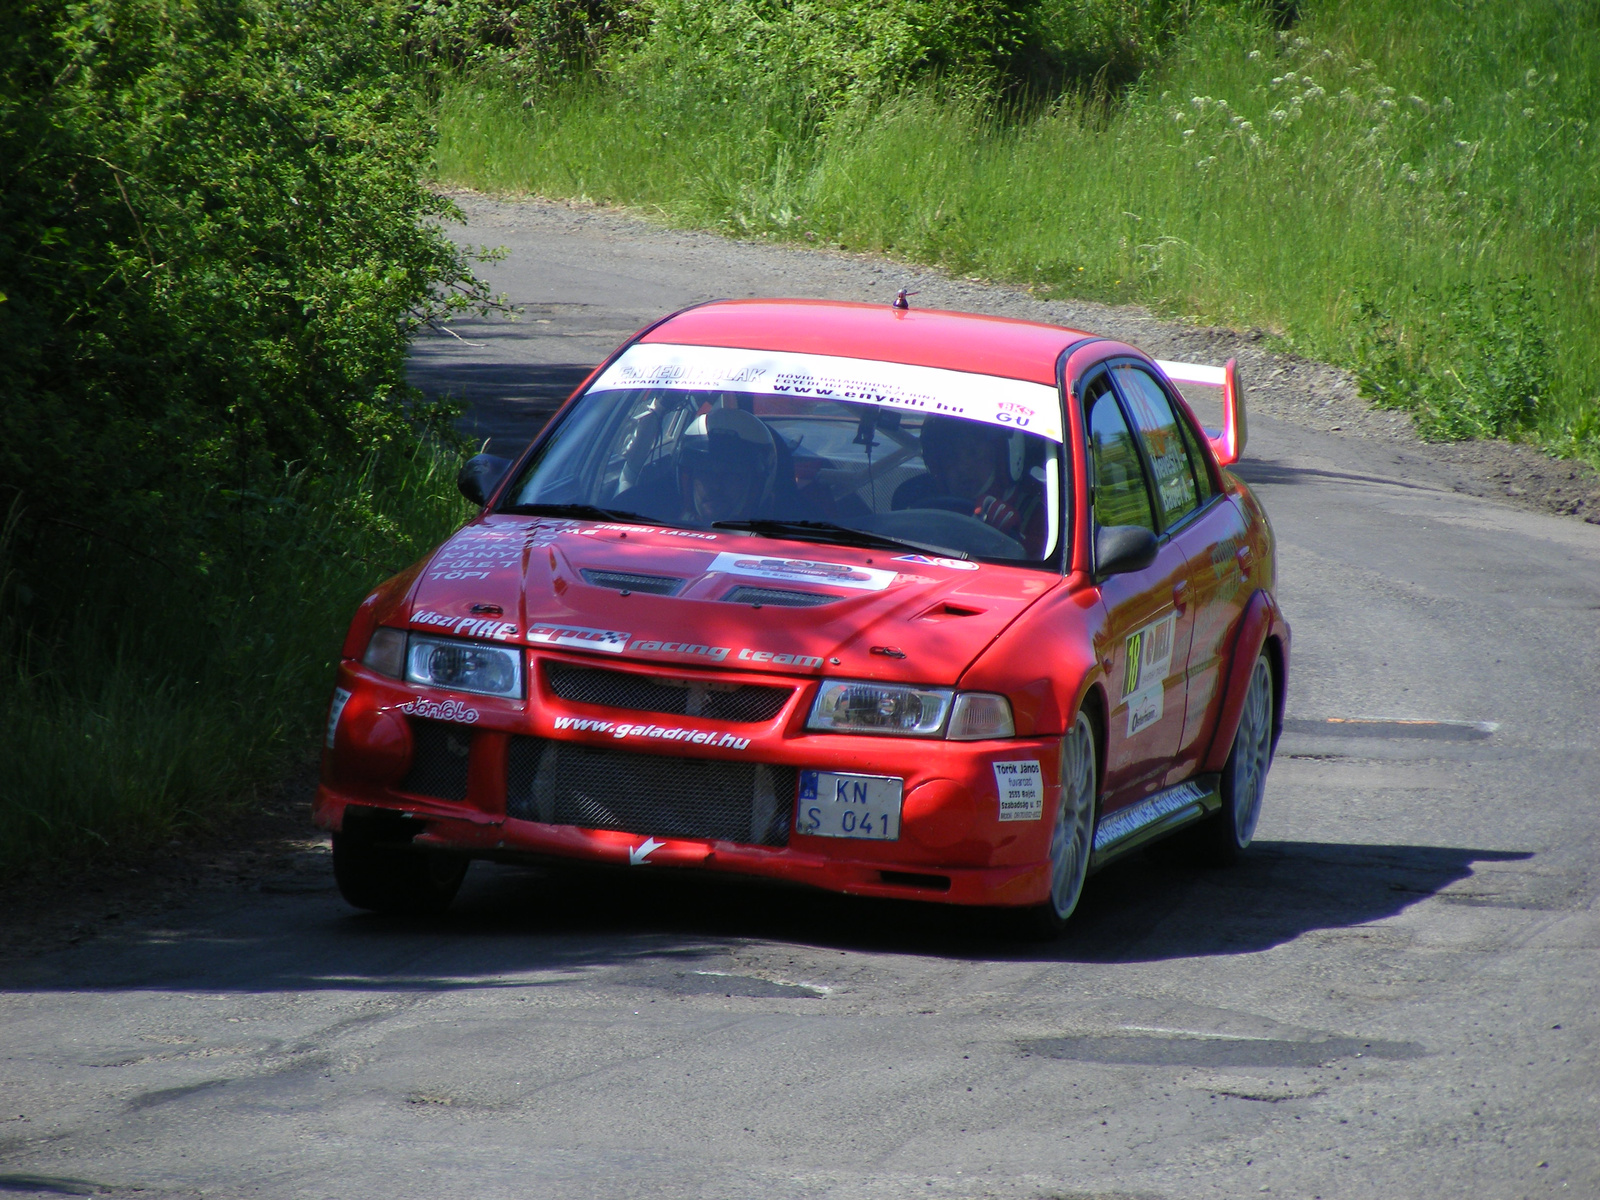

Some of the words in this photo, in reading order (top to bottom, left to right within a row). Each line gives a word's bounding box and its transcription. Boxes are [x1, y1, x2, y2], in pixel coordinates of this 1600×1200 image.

[528, 626, 604, 643] apu
[628, 638, 732, 662] racing
[737, 647, 825, 669] team
[1127, 633, 1141, 695] 18
[553, 714, 752, 751] www.galadriel.hu
[996, 763, 1018, 775] Török
[1020, 763, 1040, 774] János
[835, 778, 868, 805] KN
[807, 807, 821, 829] S
[842, 810, 888, 835] 041
